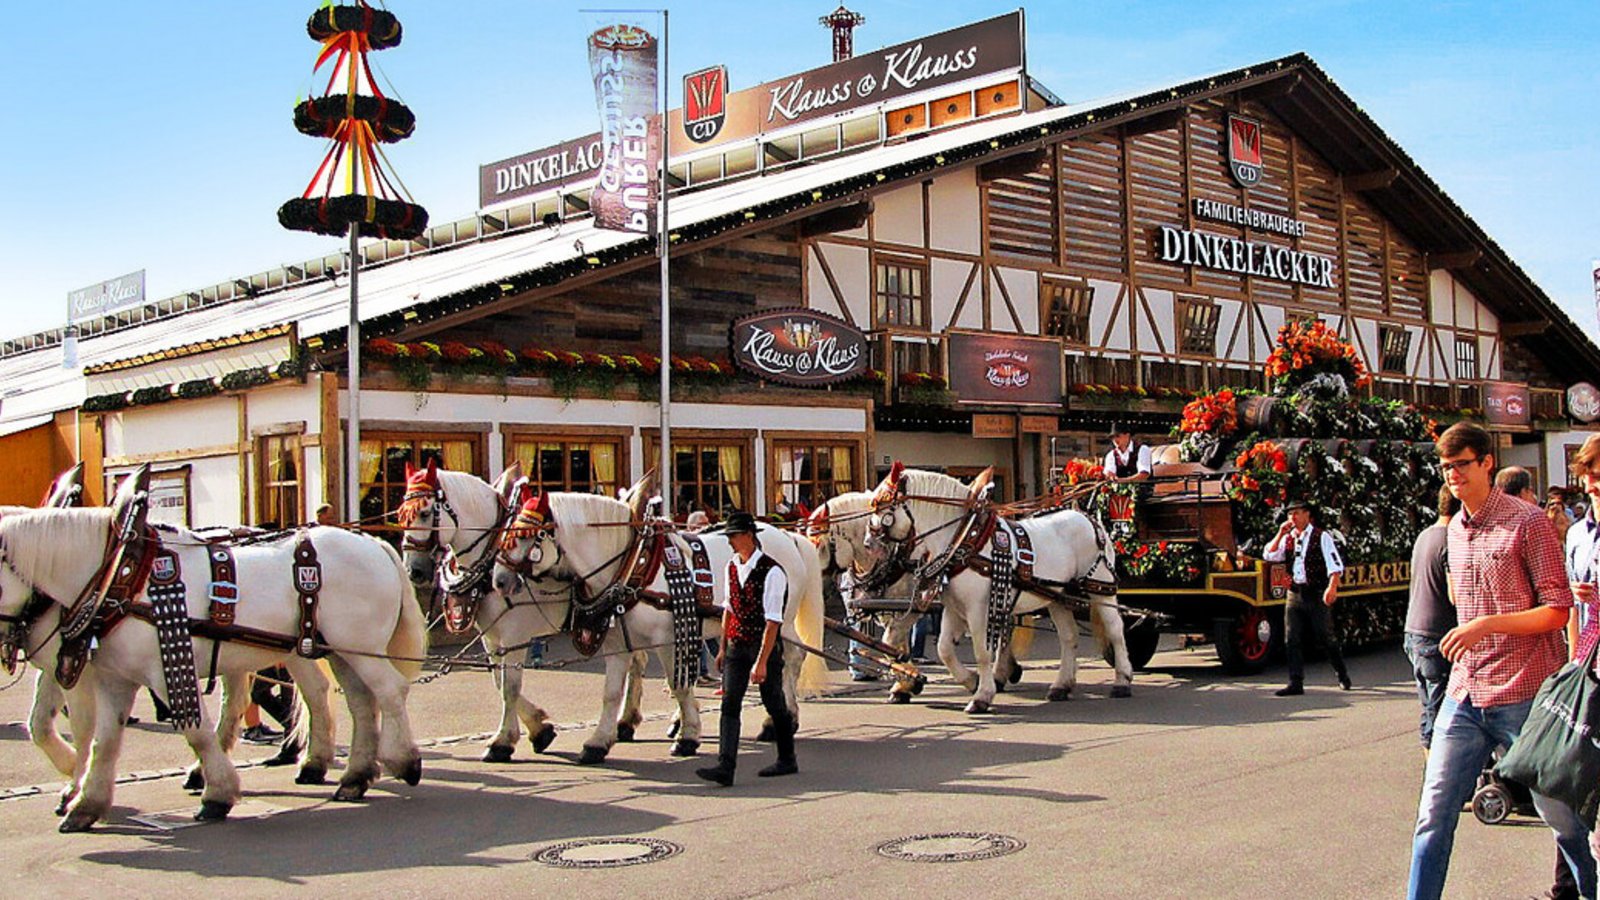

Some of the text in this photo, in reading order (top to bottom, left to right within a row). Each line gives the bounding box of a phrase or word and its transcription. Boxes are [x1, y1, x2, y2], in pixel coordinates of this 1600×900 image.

[767, 77, 851, 122] Klauss
[881, 43, 977, 91] Klauss
[692, 120, 717, 140] CD
[496, 141, 602, 195] DINKELAC
[1238, 165, 1256, 181] CD
[1196, 199, 1306, 237] FAMILIENBRAUEREI
[1162, 226, 1335, 288] DINKELACKER
[743, 324, 794, 373] Klauss
[814, 336, 860, 374] Klauss
[1339, 561, 1411, 587] ELACK
